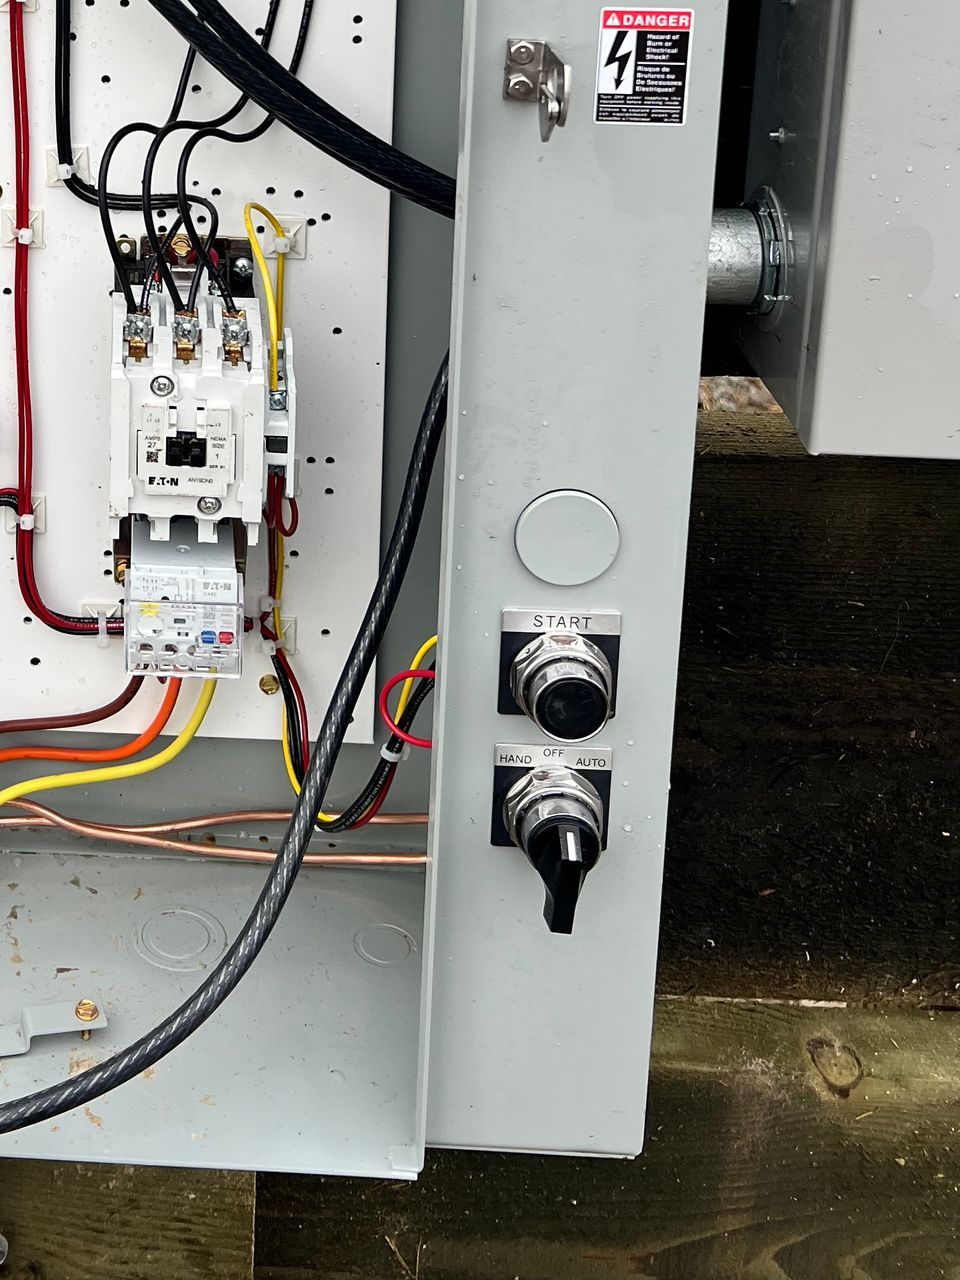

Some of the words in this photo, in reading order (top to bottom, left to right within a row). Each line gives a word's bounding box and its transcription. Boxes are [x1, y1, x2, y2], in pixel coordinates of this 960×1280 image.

[623, 14, 689, 26] DANGER
[148, 476, 179, 486] EATON
[203, 582, 231, 590] EATON
[533, 615, 592, 629] START
[499, 754, 532, 764] HAND
[543, 748, 565, 757] OFF
[576, 757, 606, 767] AUTO
